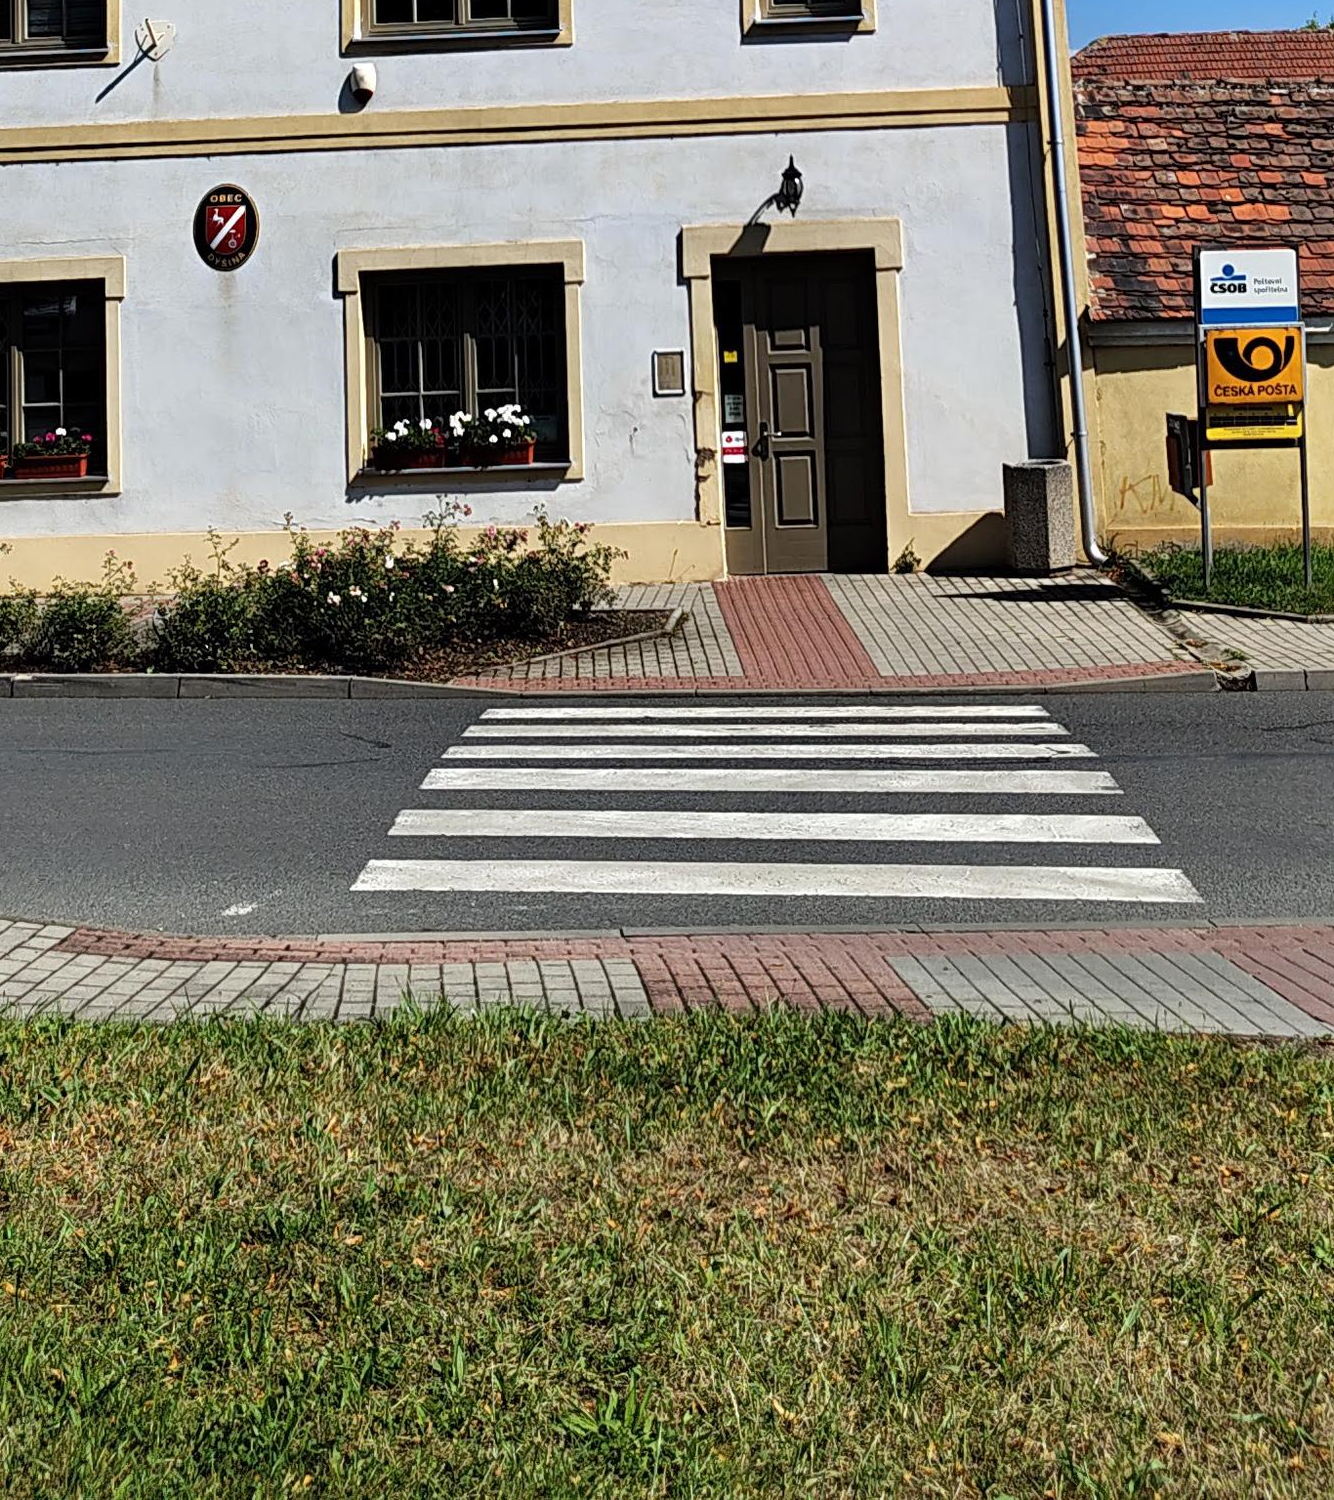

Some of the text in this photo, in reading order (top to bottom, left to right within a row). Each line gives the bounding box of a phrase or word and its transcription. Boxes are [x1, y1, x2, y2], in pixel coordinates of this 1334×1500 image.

[210, 194, 242, 203] OBEC
[1210, 282, 1247, 294] ČSOB
[1214, 383, 1298, 397] ČESKÁ POŠTA
